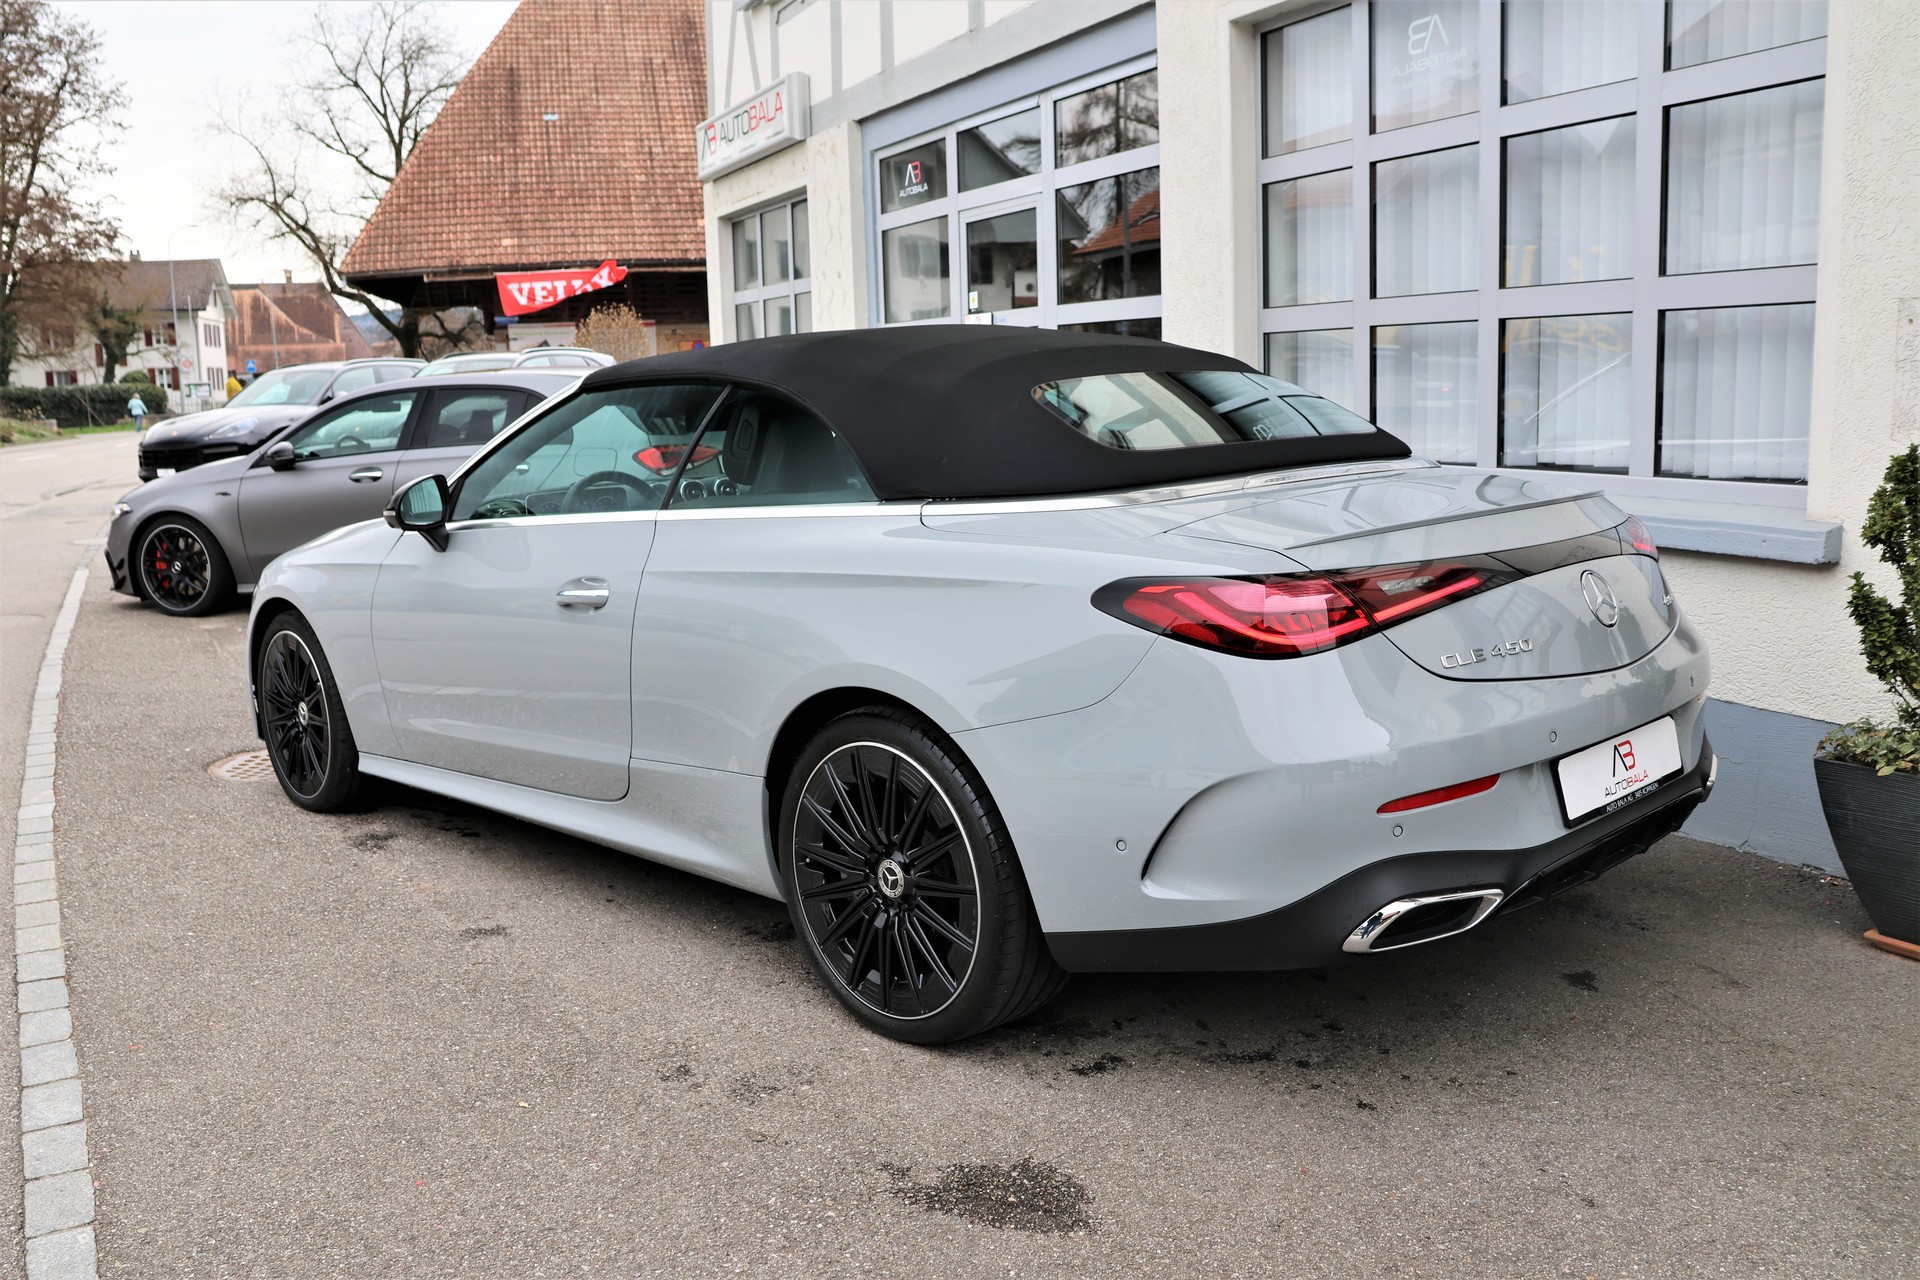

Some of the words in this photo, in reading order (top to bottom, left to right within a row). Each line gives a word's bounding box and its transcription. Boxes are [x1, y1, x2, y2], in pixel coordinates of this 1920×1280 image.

[719, 91, 784, 147] AUTOBALA
[899, 182, 928, 197] AUTOBALA
[1440, 648, 1487, 669] CLE
[1491, 638, 1534, 657] 450
[1604, 769, 1649, 798] AUTOBALA
